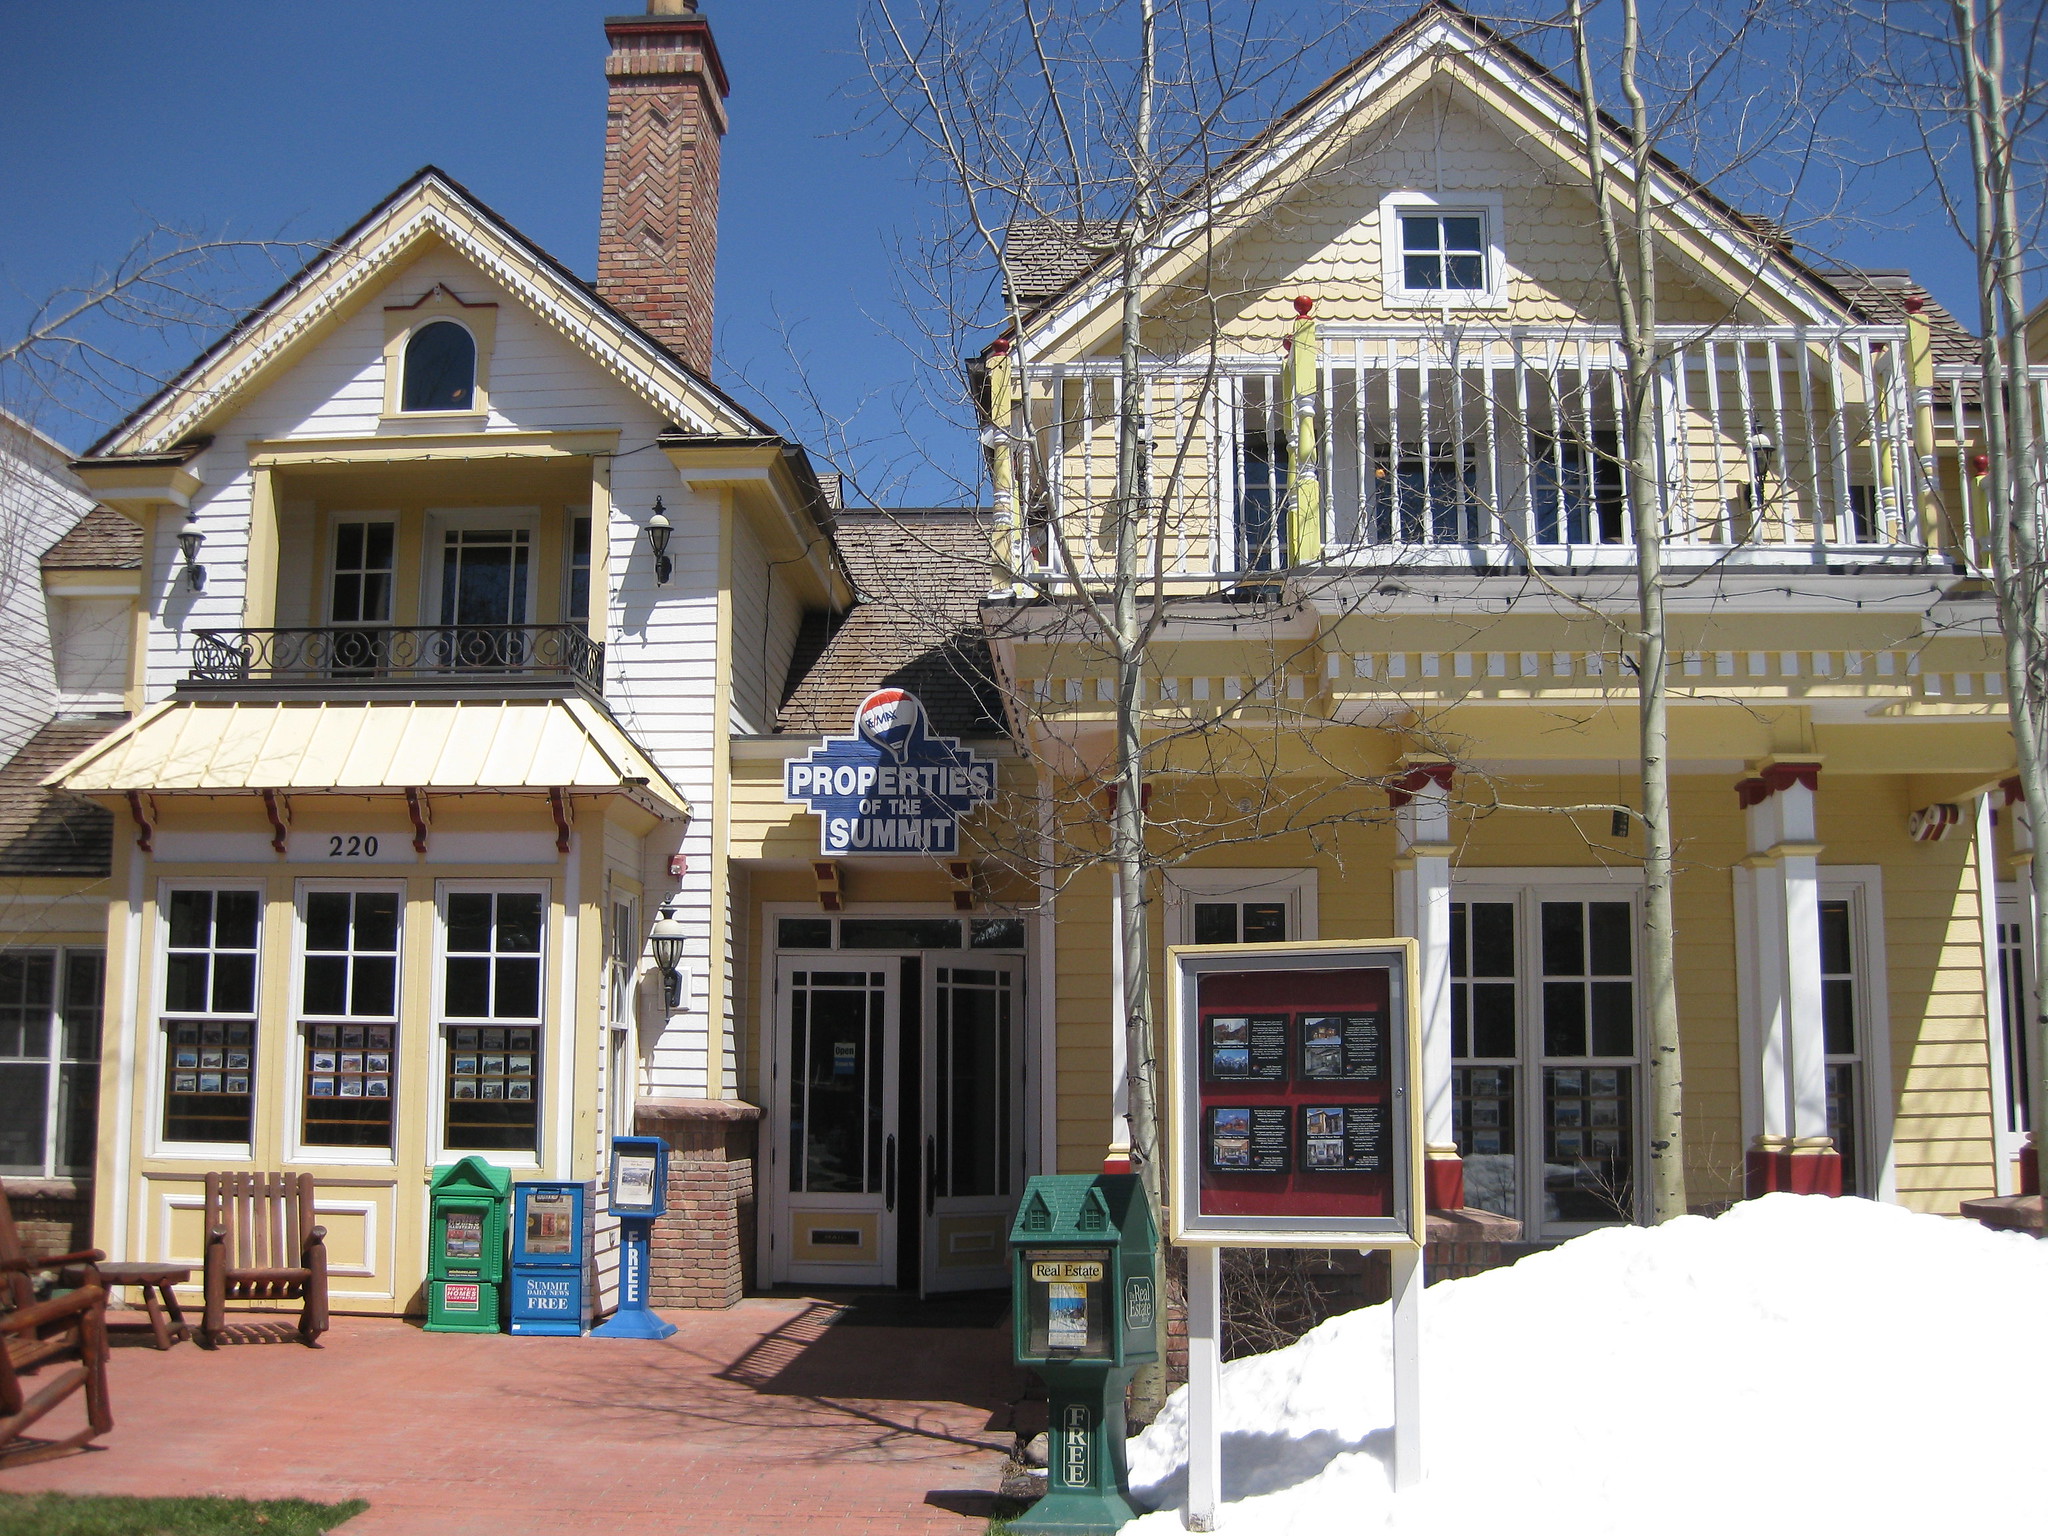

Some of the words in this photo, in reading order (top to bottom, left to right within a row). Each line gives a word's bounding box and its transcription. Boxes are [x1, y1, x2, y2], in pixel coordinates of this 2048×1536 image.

[865, 710, 898, 729] RE/MAX
[792, 766, 989, 796] PROPERTIES
[859, 799, 881, 815] OF
[889, 799, 921, 815] THE
[829, 817, 951, 848] SUMMIT
[329, 836, 378, 857] 220
[835, 1046, 854, 1056] Open
[628, 1231, 639, 1302] FREE
[1036, 1264, 1060, 1276] Real
[1065, 1264, 1099, 1276] Estate
[527, 1279, 570, 1290] SUMMIT
[1133, 1282, 1150, 1301] Real
[528, 1297, 569, 1310] FREE
[1130, 1300, 1151, 1316] Estate
[1067, 1408, 1087, 1483] FREE
